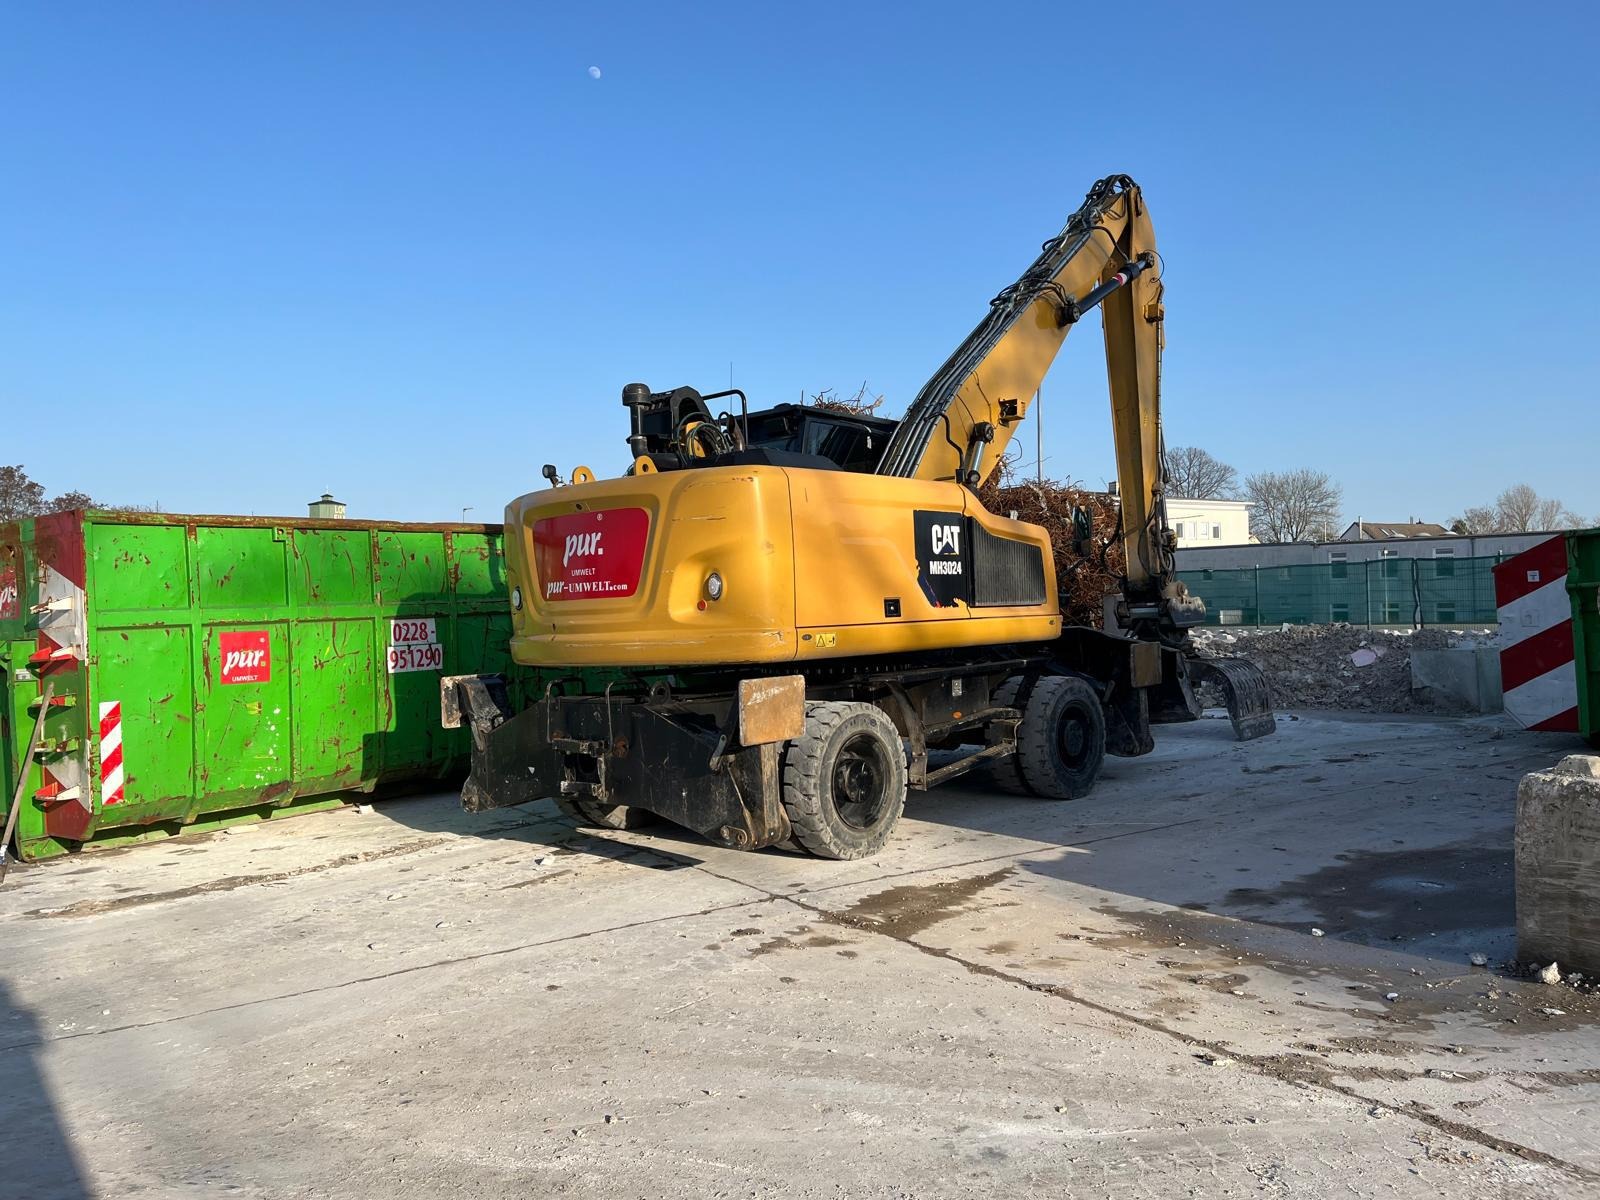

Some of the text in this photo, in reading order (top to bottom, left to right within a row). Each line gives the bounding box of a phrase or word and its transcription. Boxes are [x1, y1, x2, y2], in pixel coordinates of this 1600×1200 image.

[931, 524, 960, 555] CAT
[563, 532, 604, 568] pur.
[571, 568, 596, 577] UMWELT
[929, 560, 962, 575] MH3024
[546, 580, 628, 599] pur-UMWELT.com
[390, 647, 441, 669] 951290
